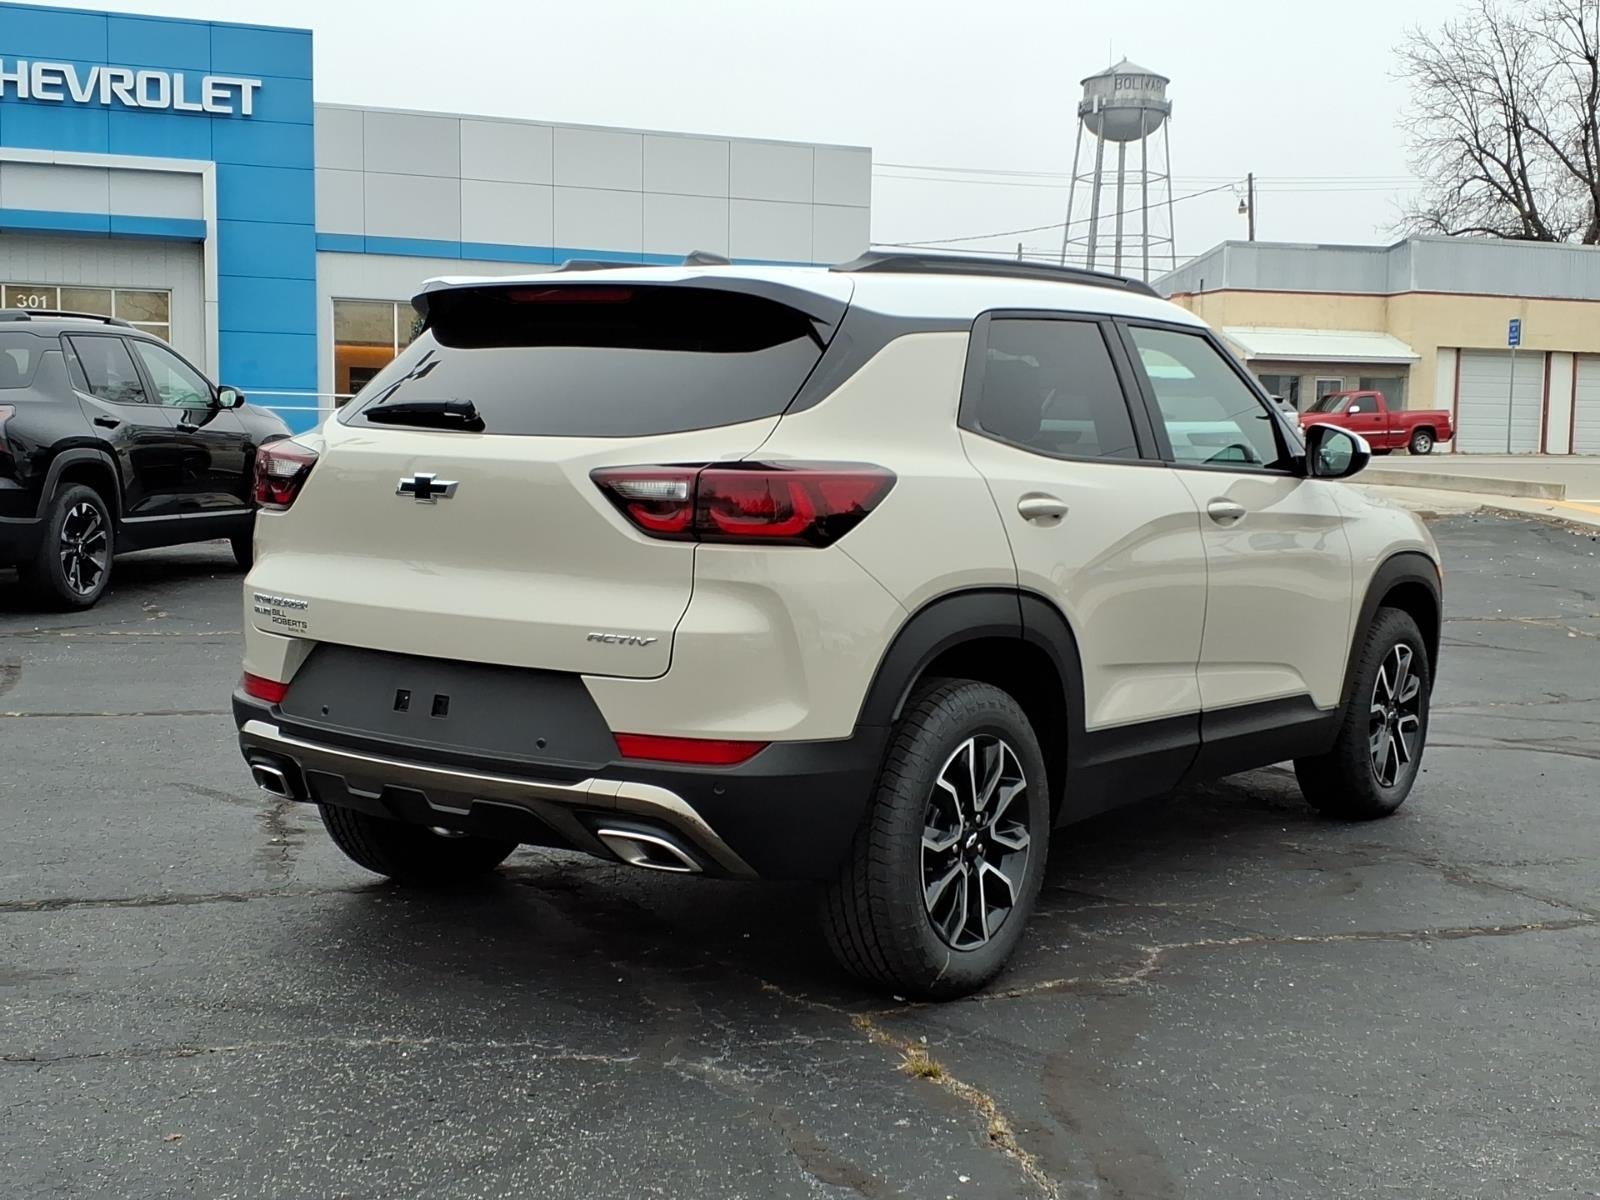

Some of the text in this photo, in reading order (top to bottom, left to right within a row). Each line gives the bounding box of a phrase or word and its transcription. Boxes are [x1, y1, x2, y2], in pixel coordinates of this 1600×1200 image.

[1114, 77, 1162, 92] BOLIVAR
[16, 294, 47, 308] 301
[272, 616, 308, 629] ROBERTS
[587, 633, 658, 646] ACTIV
